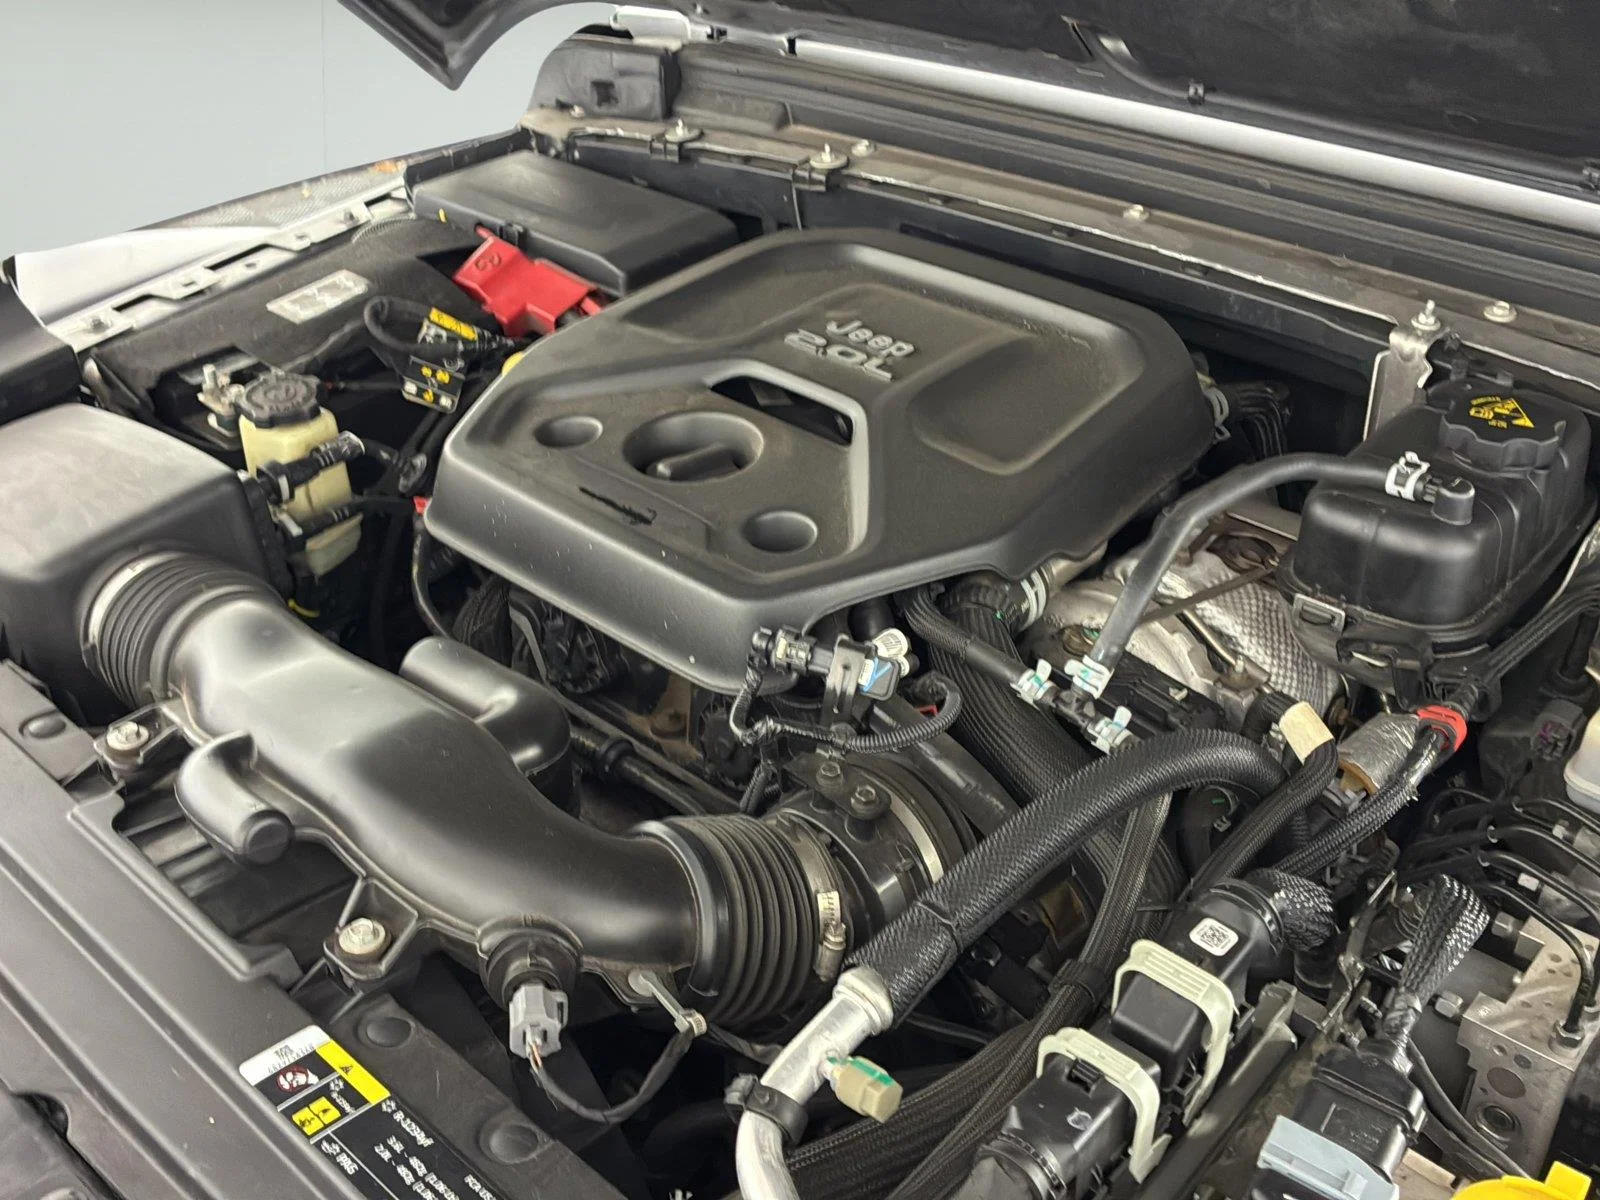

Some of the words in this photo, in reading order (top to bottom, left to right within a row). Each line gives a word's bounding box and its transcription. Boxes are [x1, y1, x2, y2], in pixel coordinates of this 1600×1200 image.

[784, 328, 892, 382] 2.0L
[825, 320, 915, 358] Jeep
[336, 1152, 359, 1175] PAG
